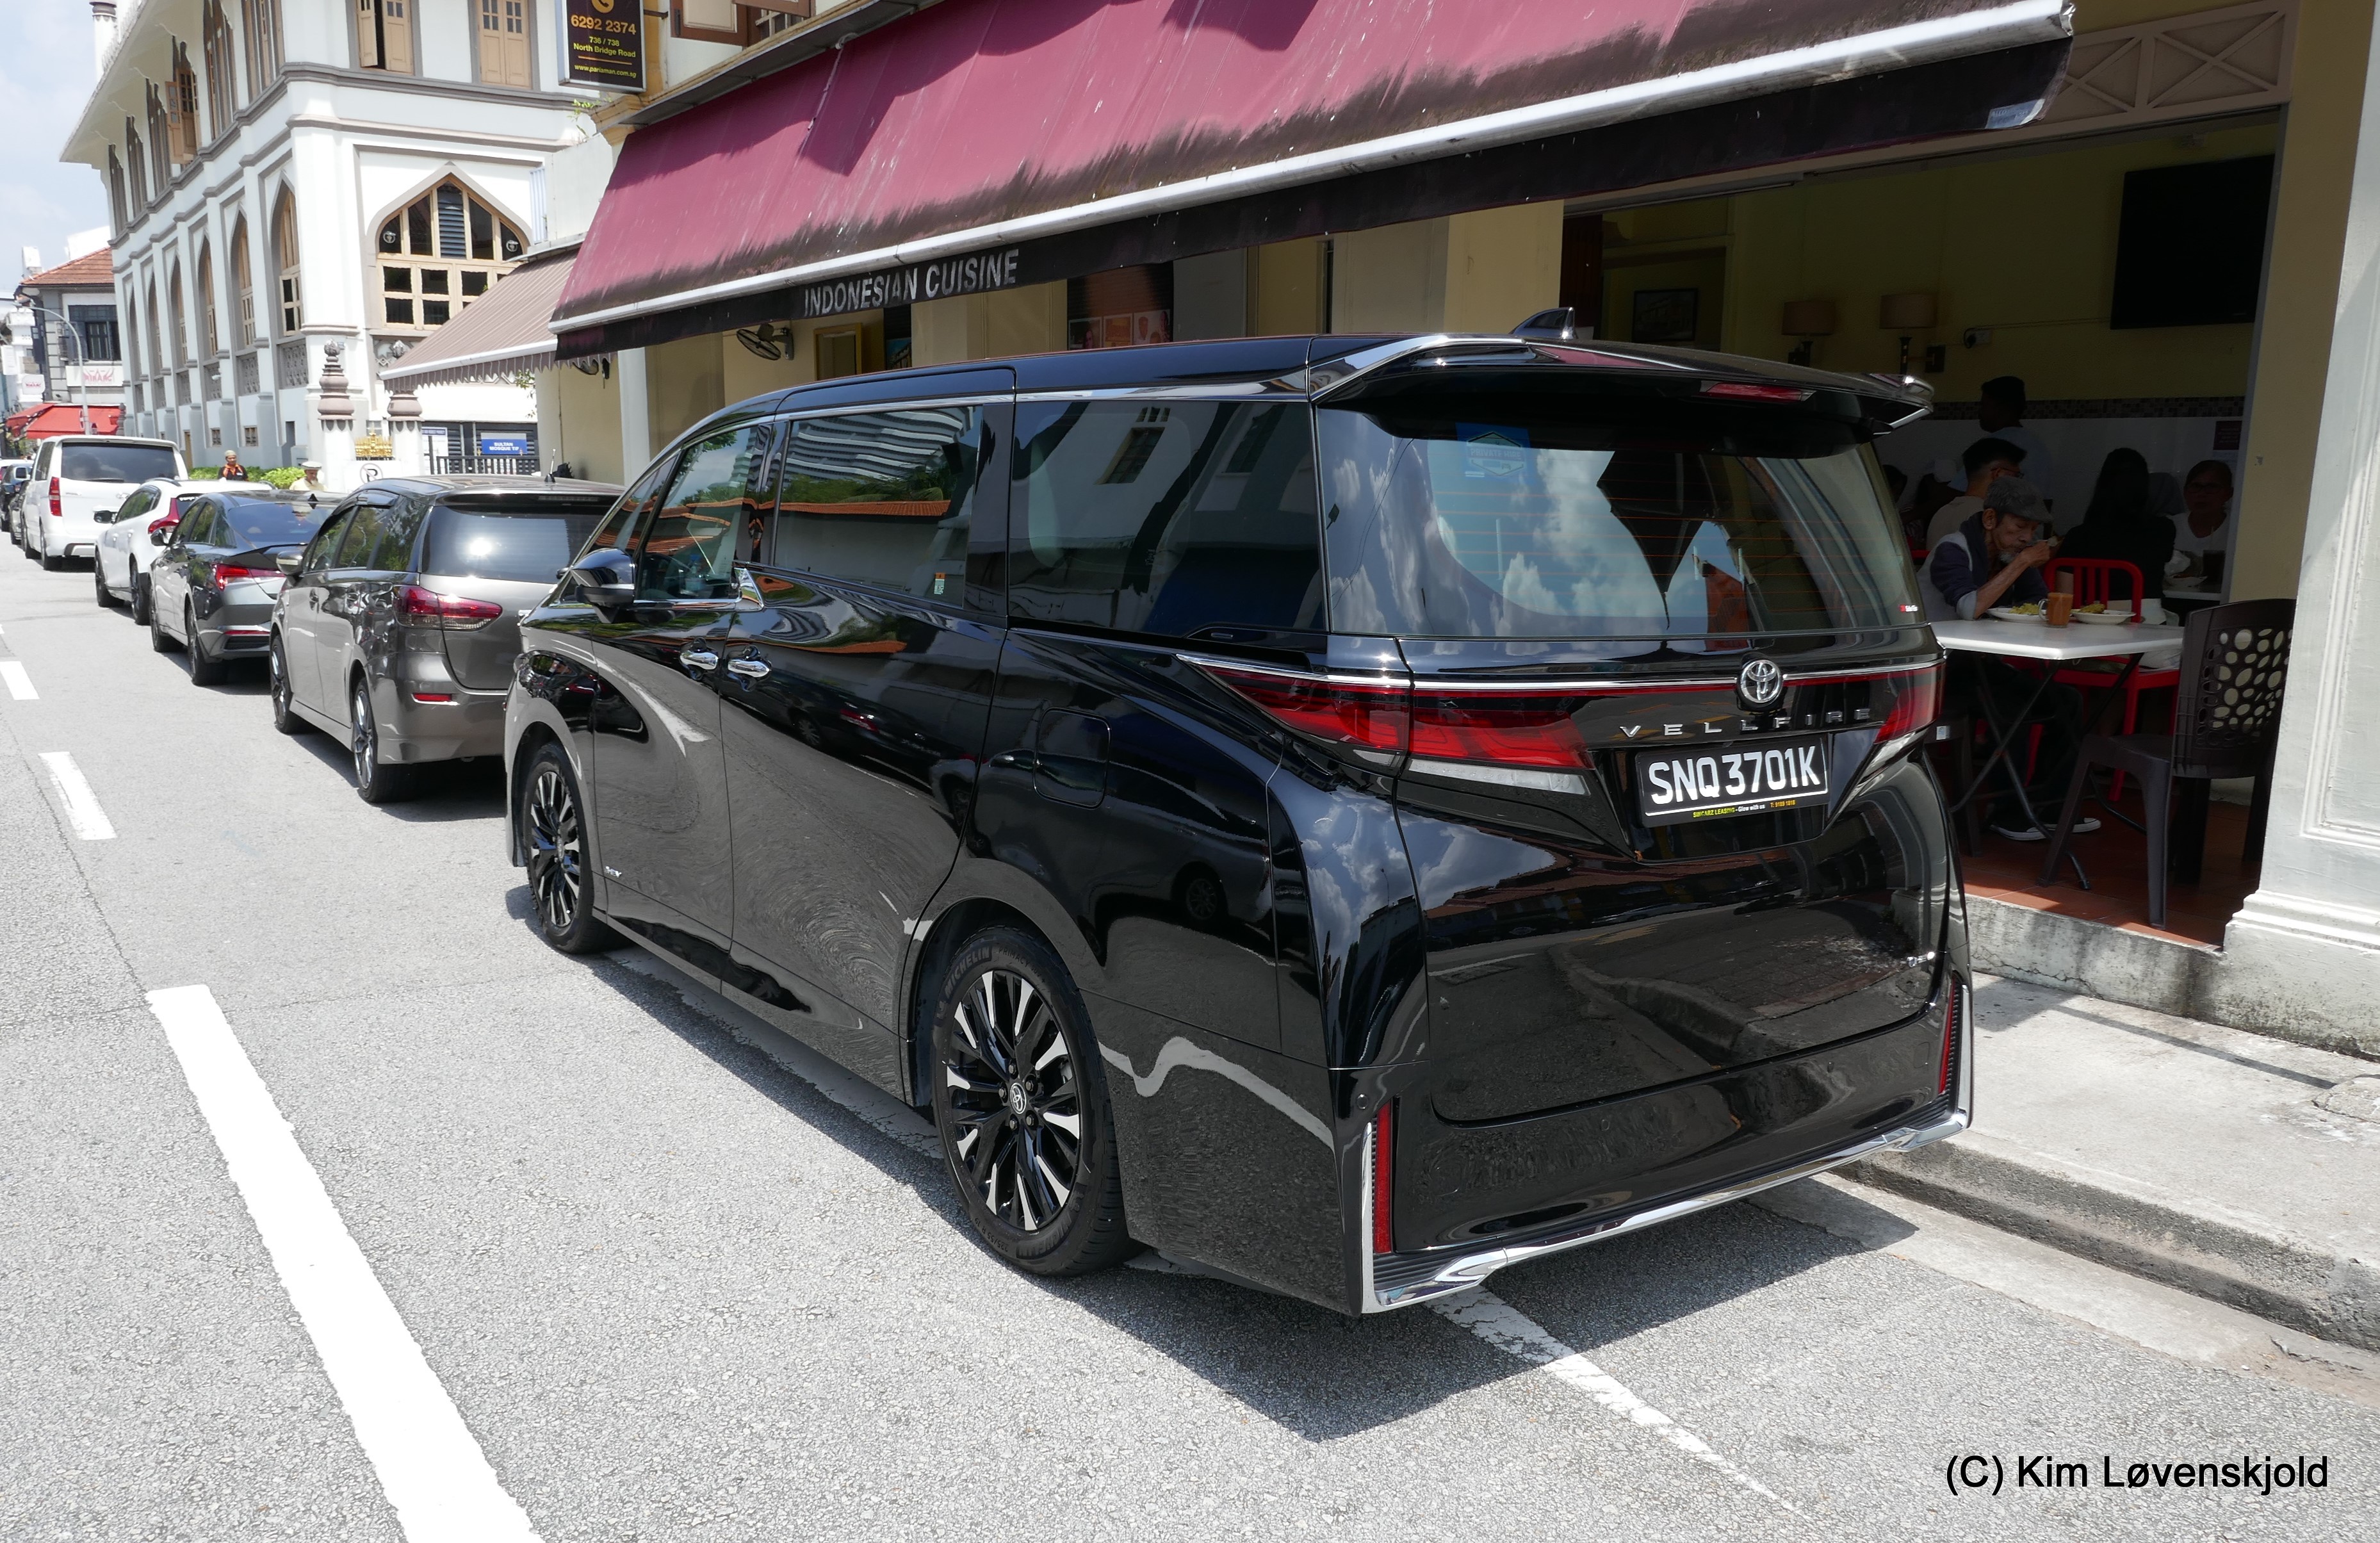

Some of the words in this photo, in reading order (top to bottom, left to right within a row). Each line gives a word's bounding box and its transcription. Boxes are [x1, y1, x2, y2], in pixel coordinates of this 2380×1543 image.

[571, 14, 603, 31] 6292
[605, 20, 637, 35] 2374
[573, 42, 593, 53] North
[594, 45, 617, 56] Bridge
[618, 49, 636, 58] Road
[608, 38, 620, 47] 738
[575, 64, 637, 79] www.pariaman.com.sg
[803, 268, 918, 318] INDONESIAN
[925, 248, 1020, 298] CUISINE
[1470, 448, 1502, 457] PRIVATE
[1504, 450, 1521, 458] HIRE
[1619, 708, 1871, 738] VELLFIRE
[1715, 807, 1735, 815] LEASING
[998, 947, 1031, 968] PRIMACY
[944, 946, 990, 999] MICHELIN
[987, 1232, 1009, 1252] 225/55
